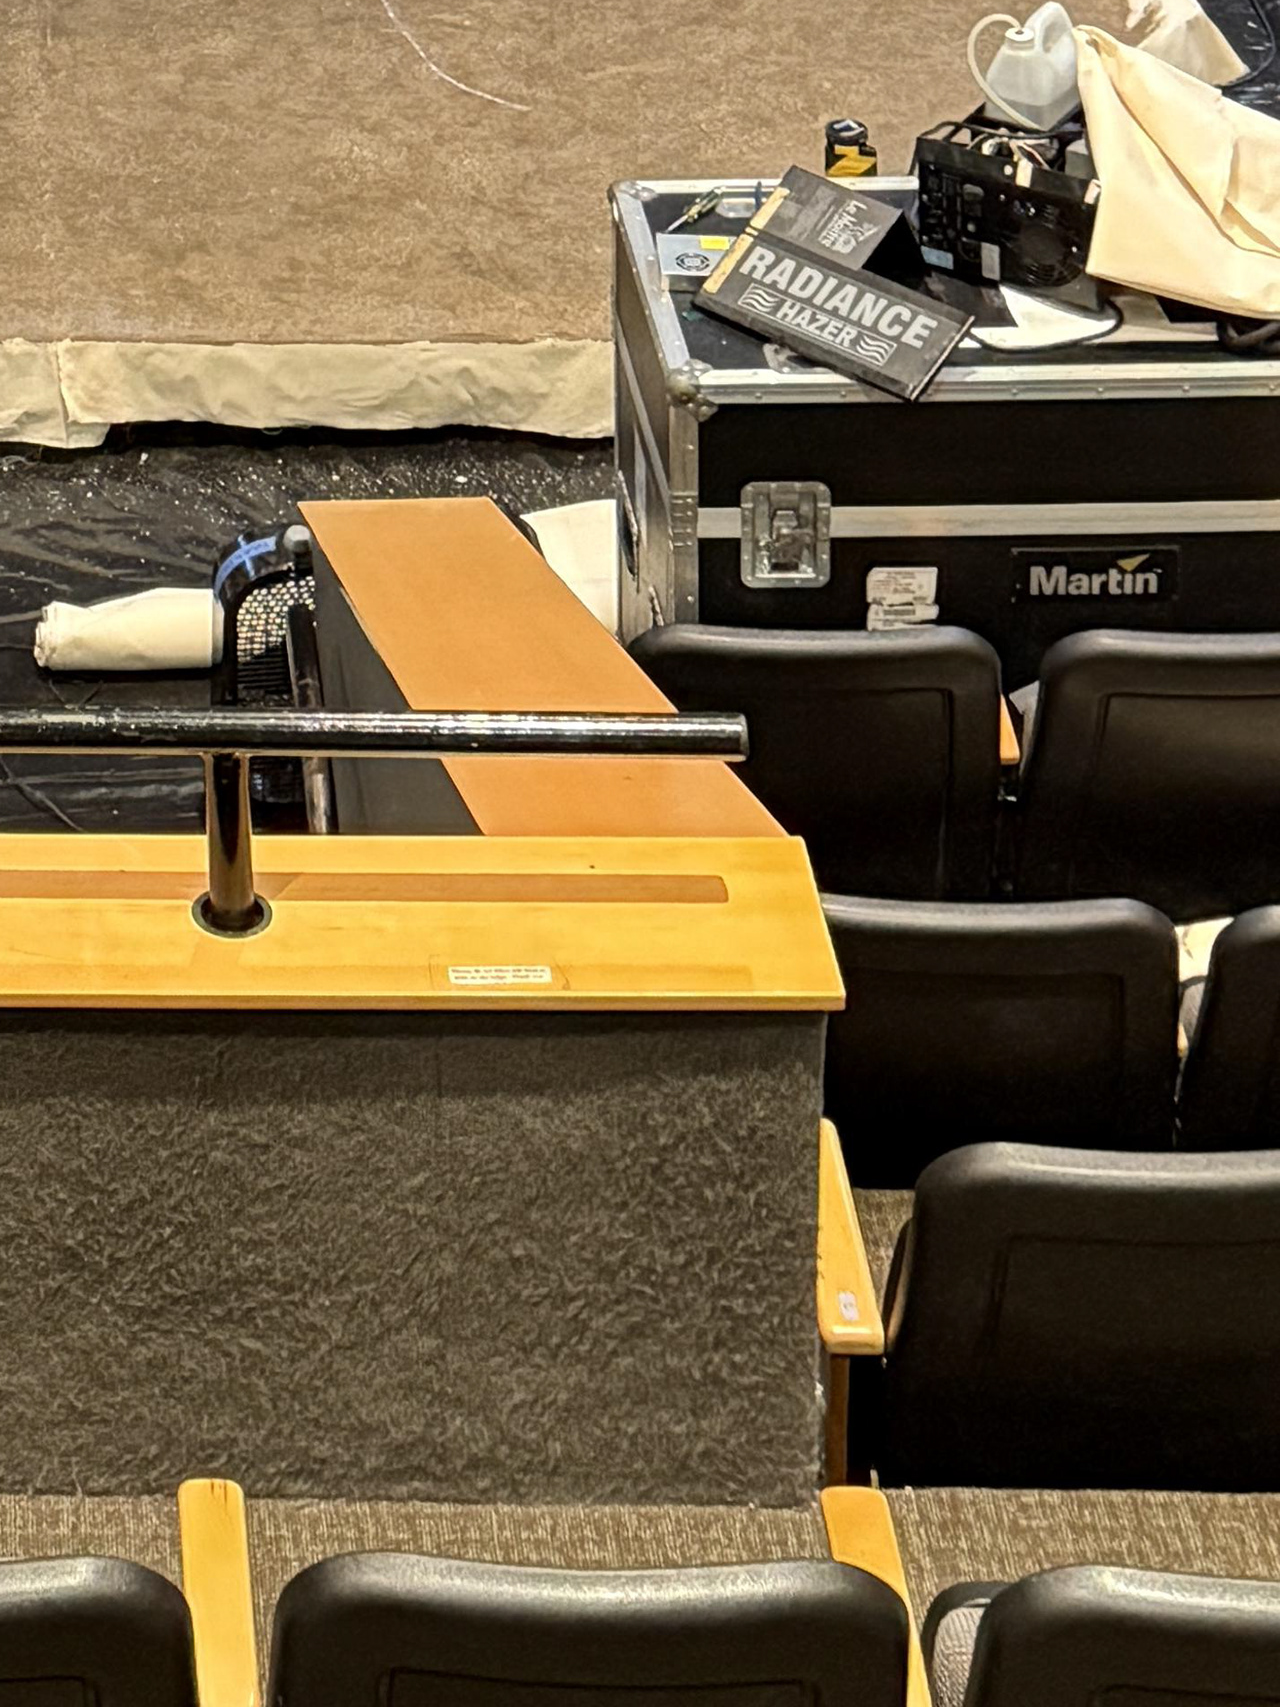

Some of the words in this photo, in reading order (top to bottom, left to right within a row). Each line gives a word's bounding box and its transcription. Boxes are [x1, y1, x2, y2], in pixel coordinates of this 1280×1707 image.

[739, 245, 938, 350] RADIANCE
[775, 299, 859, 349] HAZER
[1029, 555, 1159, 596] Martin
